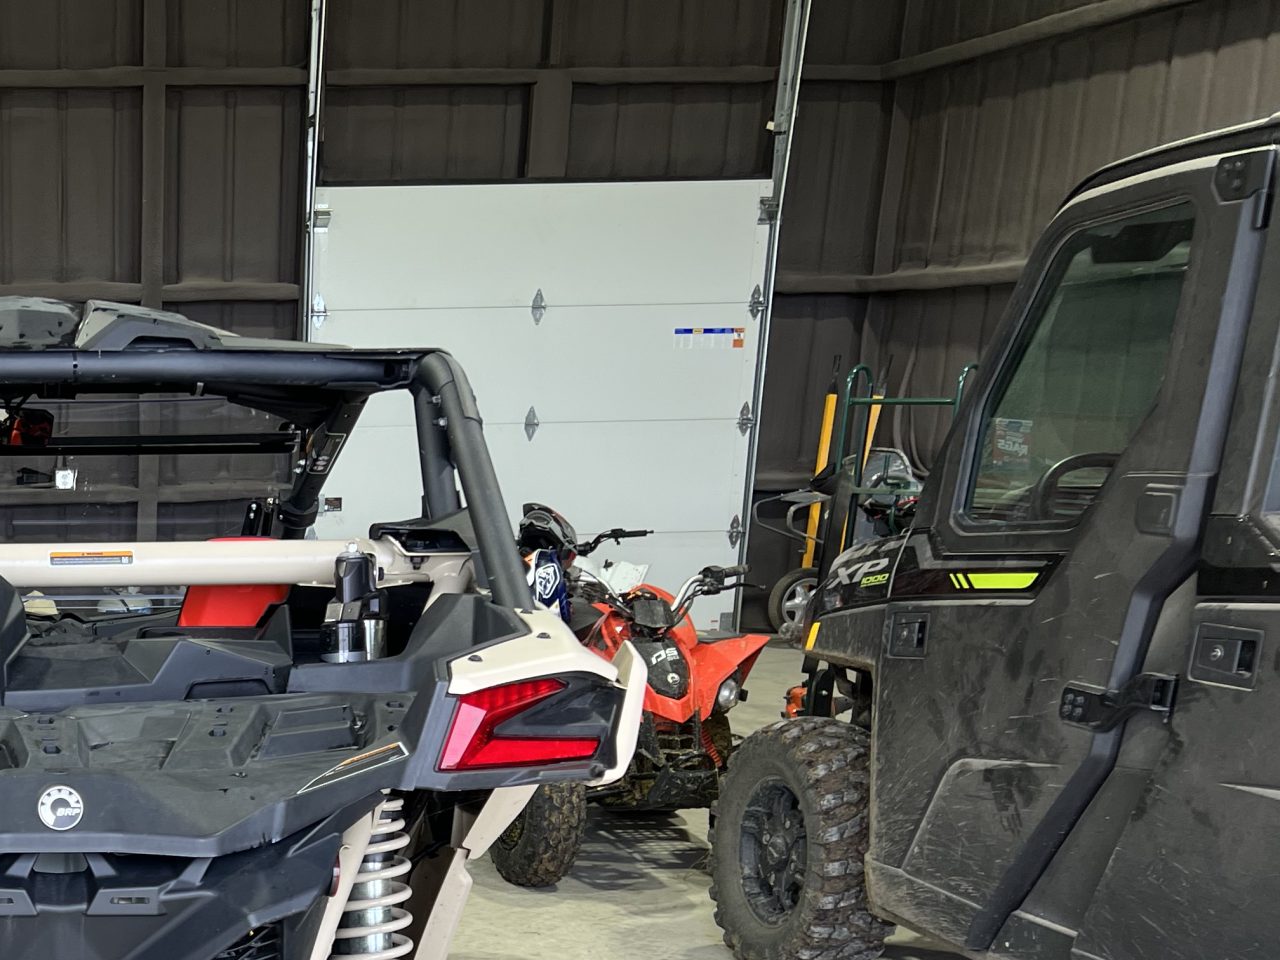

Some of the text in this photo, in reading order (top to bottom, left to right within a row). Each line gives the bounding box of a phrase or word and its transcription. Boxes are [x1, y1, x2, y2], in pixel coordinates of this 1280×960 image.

[826, 558, 889, 589] XP
[861, 573, 889, 586] 1000
[56, 807, 81, 817] BRP
